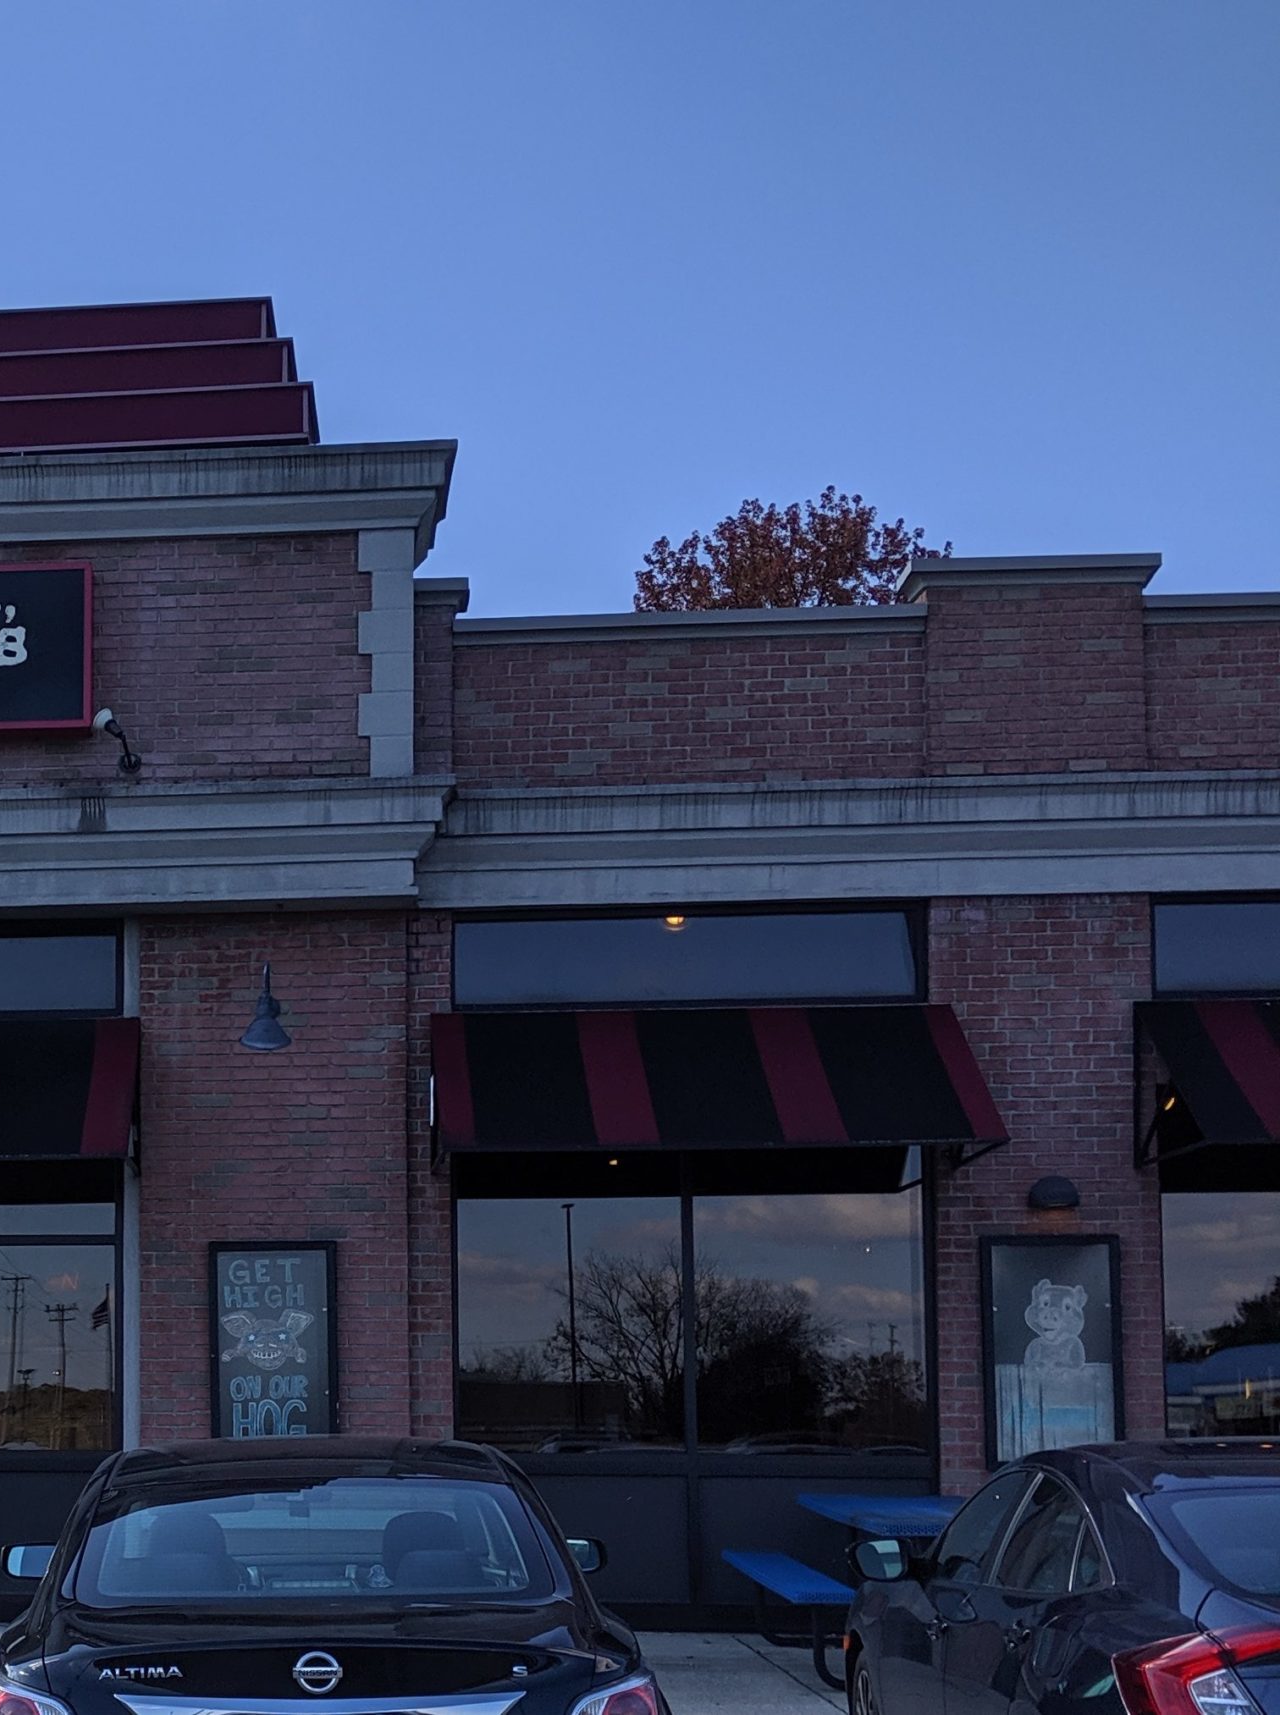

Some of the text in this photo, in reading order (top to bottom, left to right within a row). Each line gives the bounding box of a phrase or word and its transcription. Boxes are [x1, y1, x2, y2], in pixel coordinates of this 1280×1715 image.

[228, 1257, 302, 1285] GET
[224, 1284, 305, 1308] HIGH
[230, 1374, 309, 1401] ON OUR
[232, 1399, 308, 1440] HOG
[98, 1666, 184, 1681] ALTIMA
[512, 1665, 528, 1677] S
